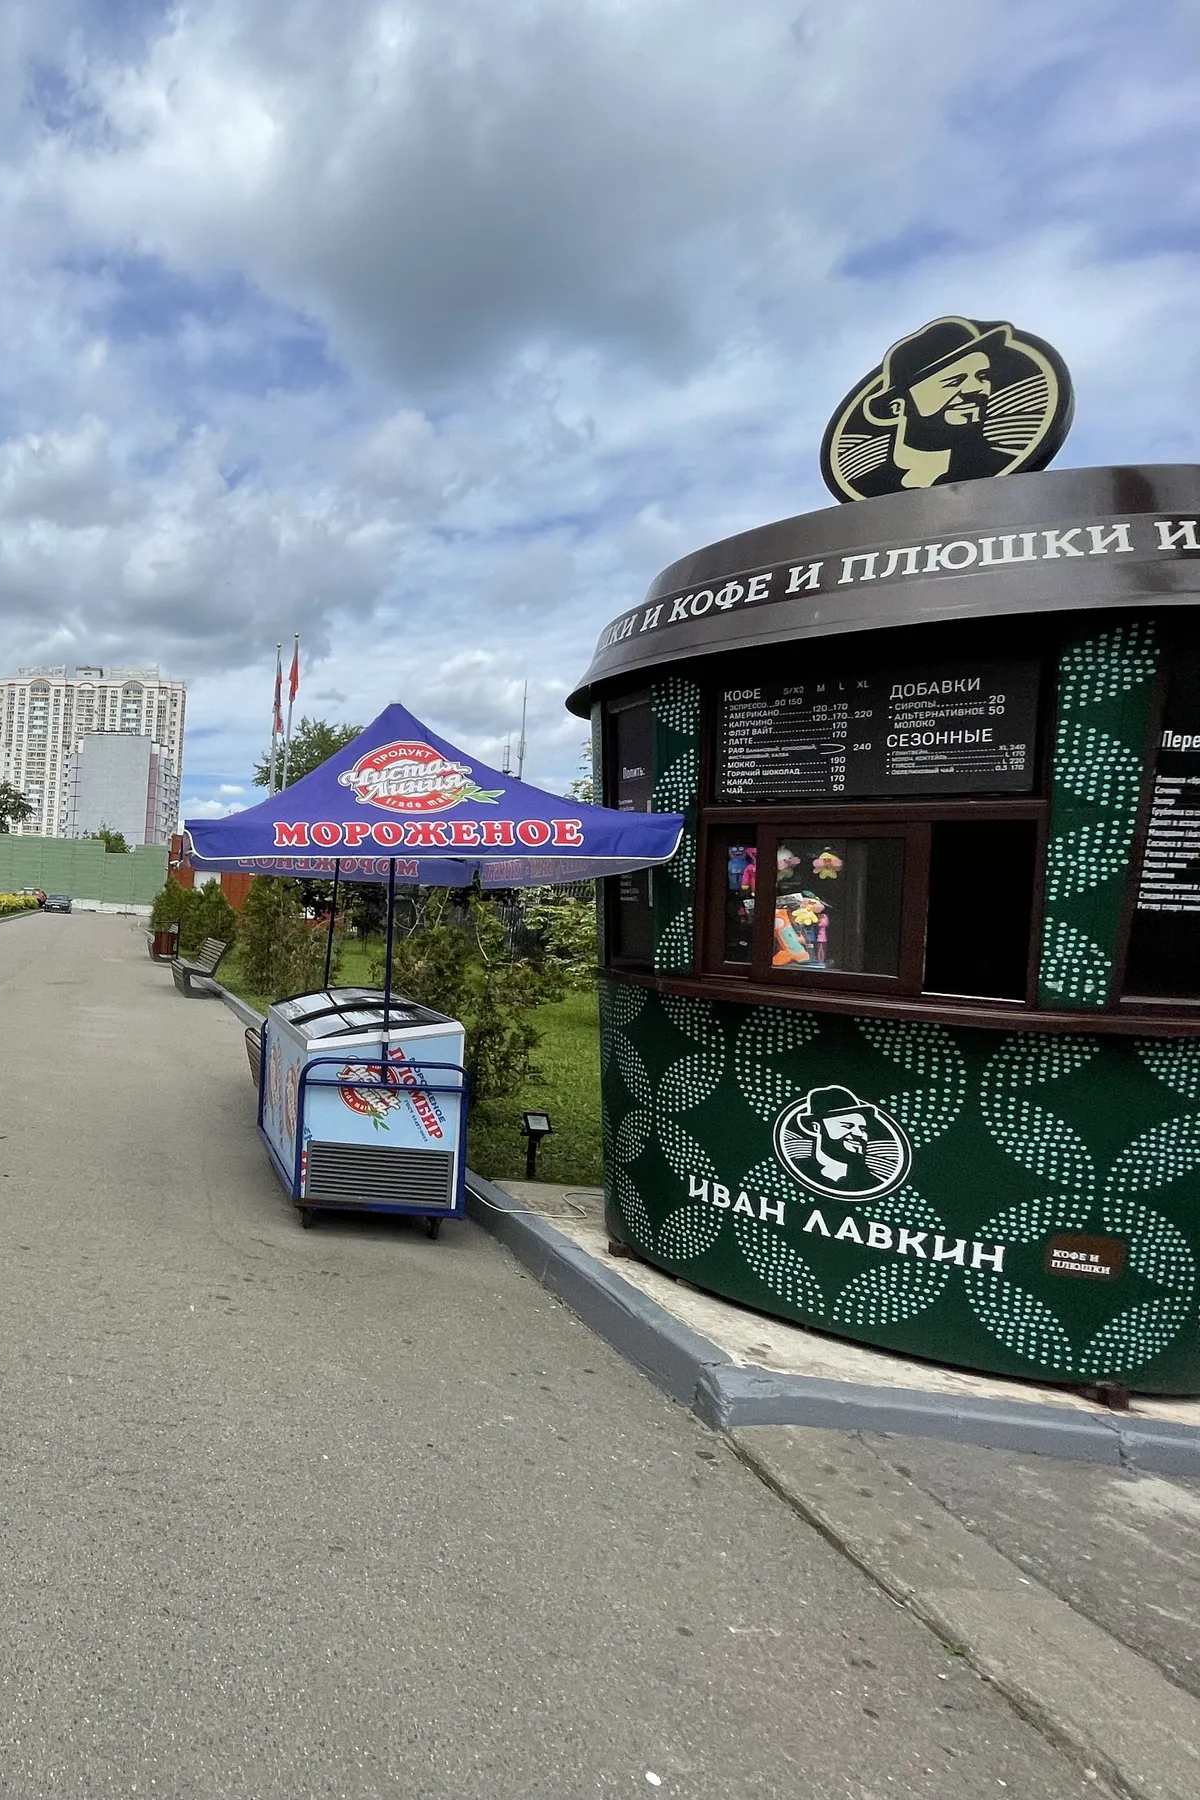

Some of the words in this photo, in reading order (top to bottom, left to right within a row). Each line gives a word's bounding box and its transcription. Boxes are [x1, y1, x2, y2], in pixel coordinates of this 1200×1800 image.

[640, 603, 664, 632] И
[667, 573, 772, 624] КОФЕ
[785, 562, 824, 594] И
[837, 522, 1135, 585] ПЛЮШКИ
[1153, 520, 1200, 550] И
[724, 688, 761, 702] КОФЕ
[817, 684, 825, 692] M
[838, 682, 845, 690] L
[856, 680, 870, 688] XL
[889, 677, 981, 700] ДОБАВКИ
[774, 699, 786, 707] 90
[788, 697, 803, 706] 150
[894, 700, 937, 711] СИРОПЫ
[988, 694, 1006, 704] 20
[728, 718, 773, 728] КАПУЧИНО
[812, 713, 828, 722] 120
[833, 712, 848, 720] 170
[854, 709, 873, 718] 220
[729, 709, 780, 720] АМЕРИКАНО
[812, 704, 828, 713] 120
[833, 702, 848, 711] 170
[894, 706, 985, 721] АЛЬТЕРНАТИВНОЕ
[988, 705, 1005, 715] 50
[728, 729, 750, 737] ФЛЭТ
[751, 726, 773, 736] ВАЙТ
[832, 721, 848, 729] 170
[894, 719, 936, 729] МОЛОКО
[728, 738, 753, 746] ЛАТТЕ
[832, 731, 847, 739] 170
[886, 728, 993, 748] СЕЗОННЫЕ
[372, 748, 433, 765] ПРОДУКТ
[728, 747, 745, 755] РАФ
[853, 743, 872, 751] 240
[727, 761, 756, 769] МОККО
[830, 756, 846, 764] 190
[338, 758, 473, 790] Чистая
[727, 769, 761, 778] ГОРЯЧИЙ
[762, 768, 801, 777] ШОКОЛАД
[830, 765, 846, 773] 170
[727, 778, 754, 786] КАКАО
[830, 775, 846, 783] 170
[356, 774, 476, 804] Линия
[726, 786, 743, 794] ЧАЙ
[832, 784, 845, 792] 50
[273, 819, 585, 847] МОРОЖЕНОЕ
[688, 1174, 786, 1226] ИВАН
[802, 1209, 1006, 1273] ЛАВКИН
[1052, 1249, 1087, 1261] КОФЕ
[1089, 1254, 1100, 1263] И
[1050, 1260, 1111, 1275] ПЛЮШКИ
